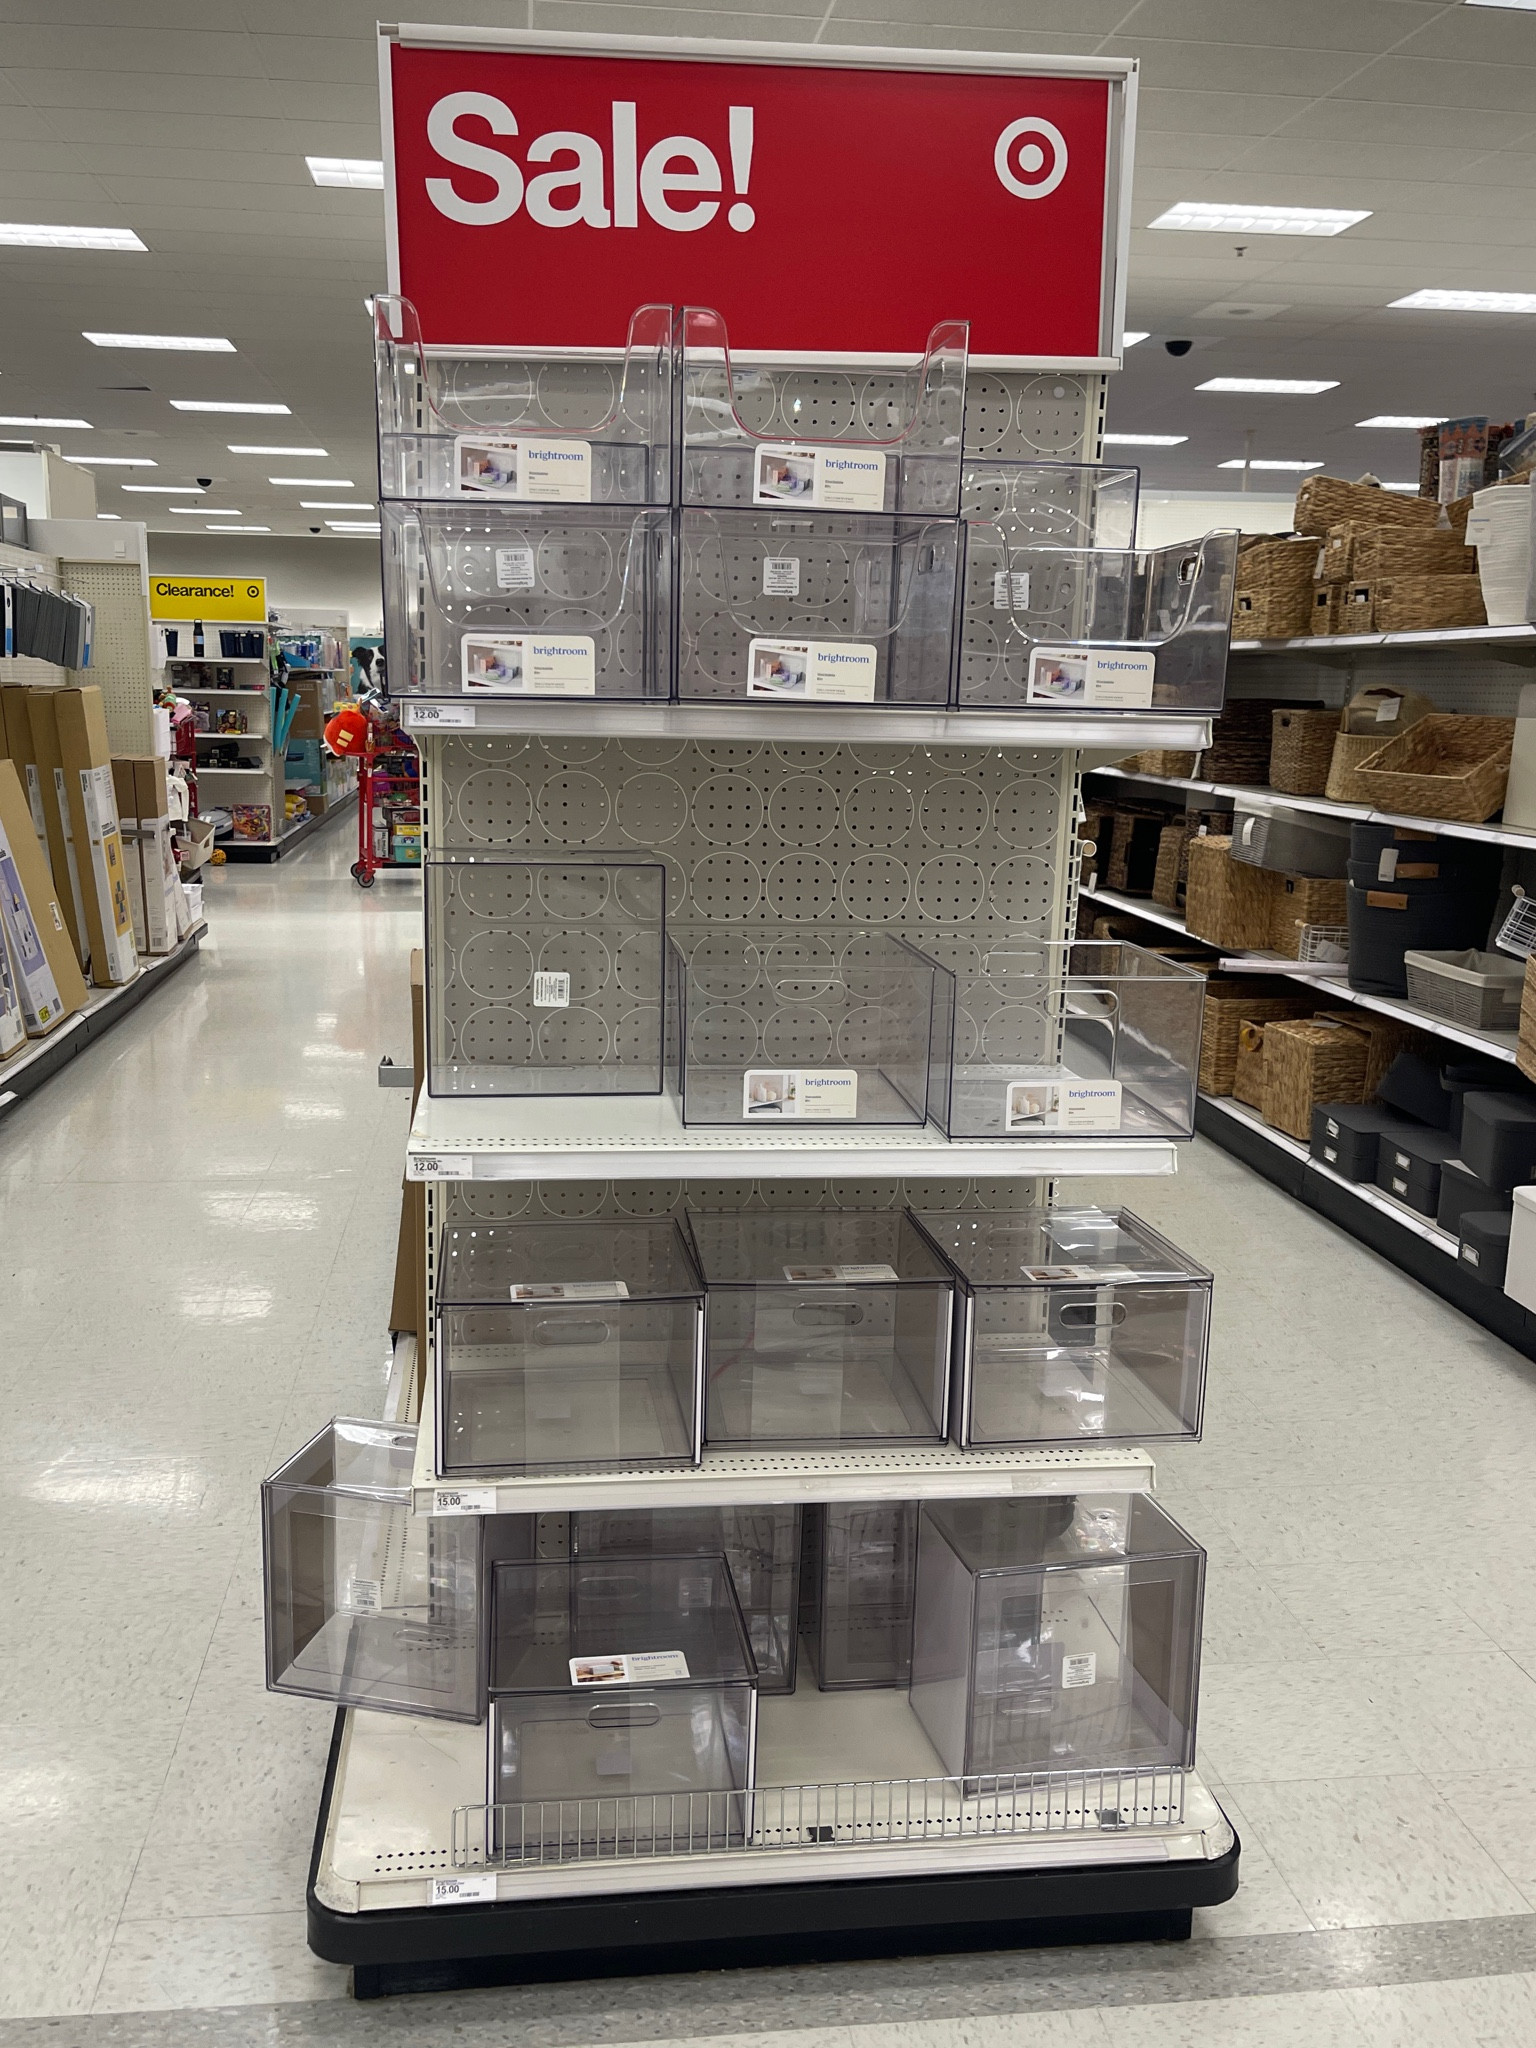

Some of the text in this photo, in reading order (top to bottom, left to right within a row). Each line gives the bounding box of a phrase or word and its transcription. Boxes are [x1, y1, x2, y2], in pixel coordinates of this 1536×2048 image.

[425, 91, 756, 233] Sale!
[528, 450, 584, 461] brightroom
[825, 459, 879, 471] brightroom
[156, 582, 235, 598] Clearance!
[533, 646, 588, 657] brightroom
[817, 653, 870, 664] brightroom
[1097, 660, 1148, 671] brightroom
[413, 711, 440, 719] 12.00
[805, 1078, 851, 1087] brightroom
[1069, 1090, 1116, 1099] brightroom
[413, 1162, 439, 1171] 12.00
[437, 1497, 461, 1506] 15.00
[436, 1884, 460, 1894] 15.00
